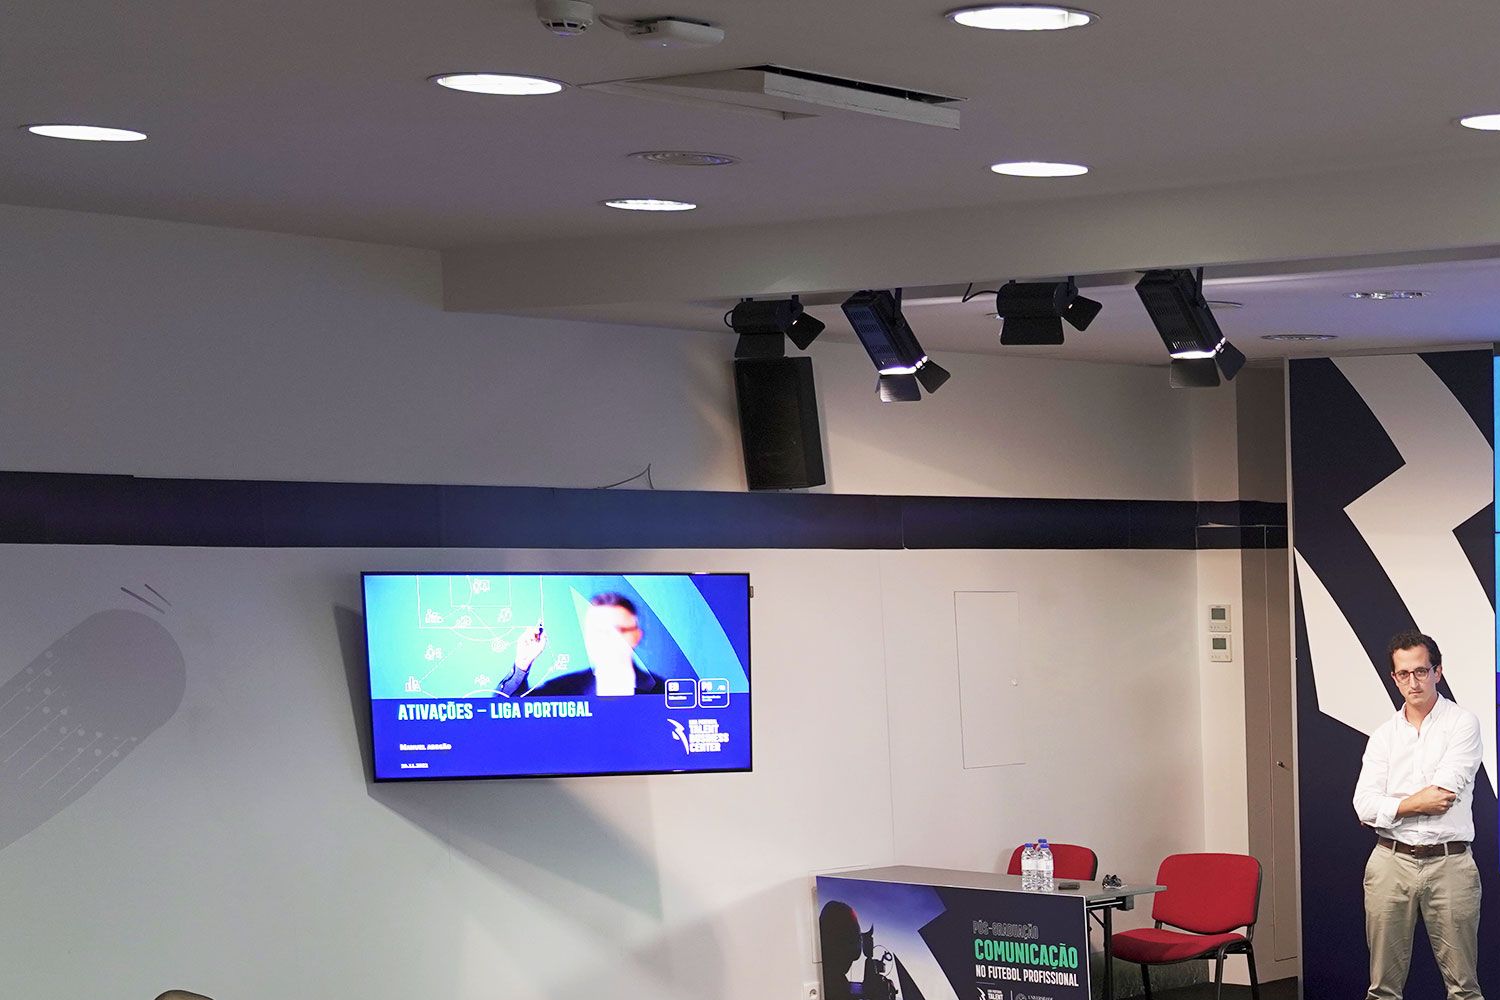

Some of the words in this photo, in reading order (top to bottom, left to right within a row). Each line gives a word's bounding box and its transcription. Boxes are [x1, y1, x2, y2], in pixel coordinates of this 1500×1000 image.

[398, 701, 473, 722] ATIVAÇÕES
[490, 702, 521, 719] LIGA
[524, 701, 593, 719] PORTUGAL
[972, 919, 1039, 940] PÓS-GRADUAÇÃO
[974, 938, 1079, 970] COMUNICAÇÃO
[975, 964, 986, 978] NO
[987, 965, 1022, 982] FUTEBOL
[1023, 969, 1080, 987] PROFISSIONAL
